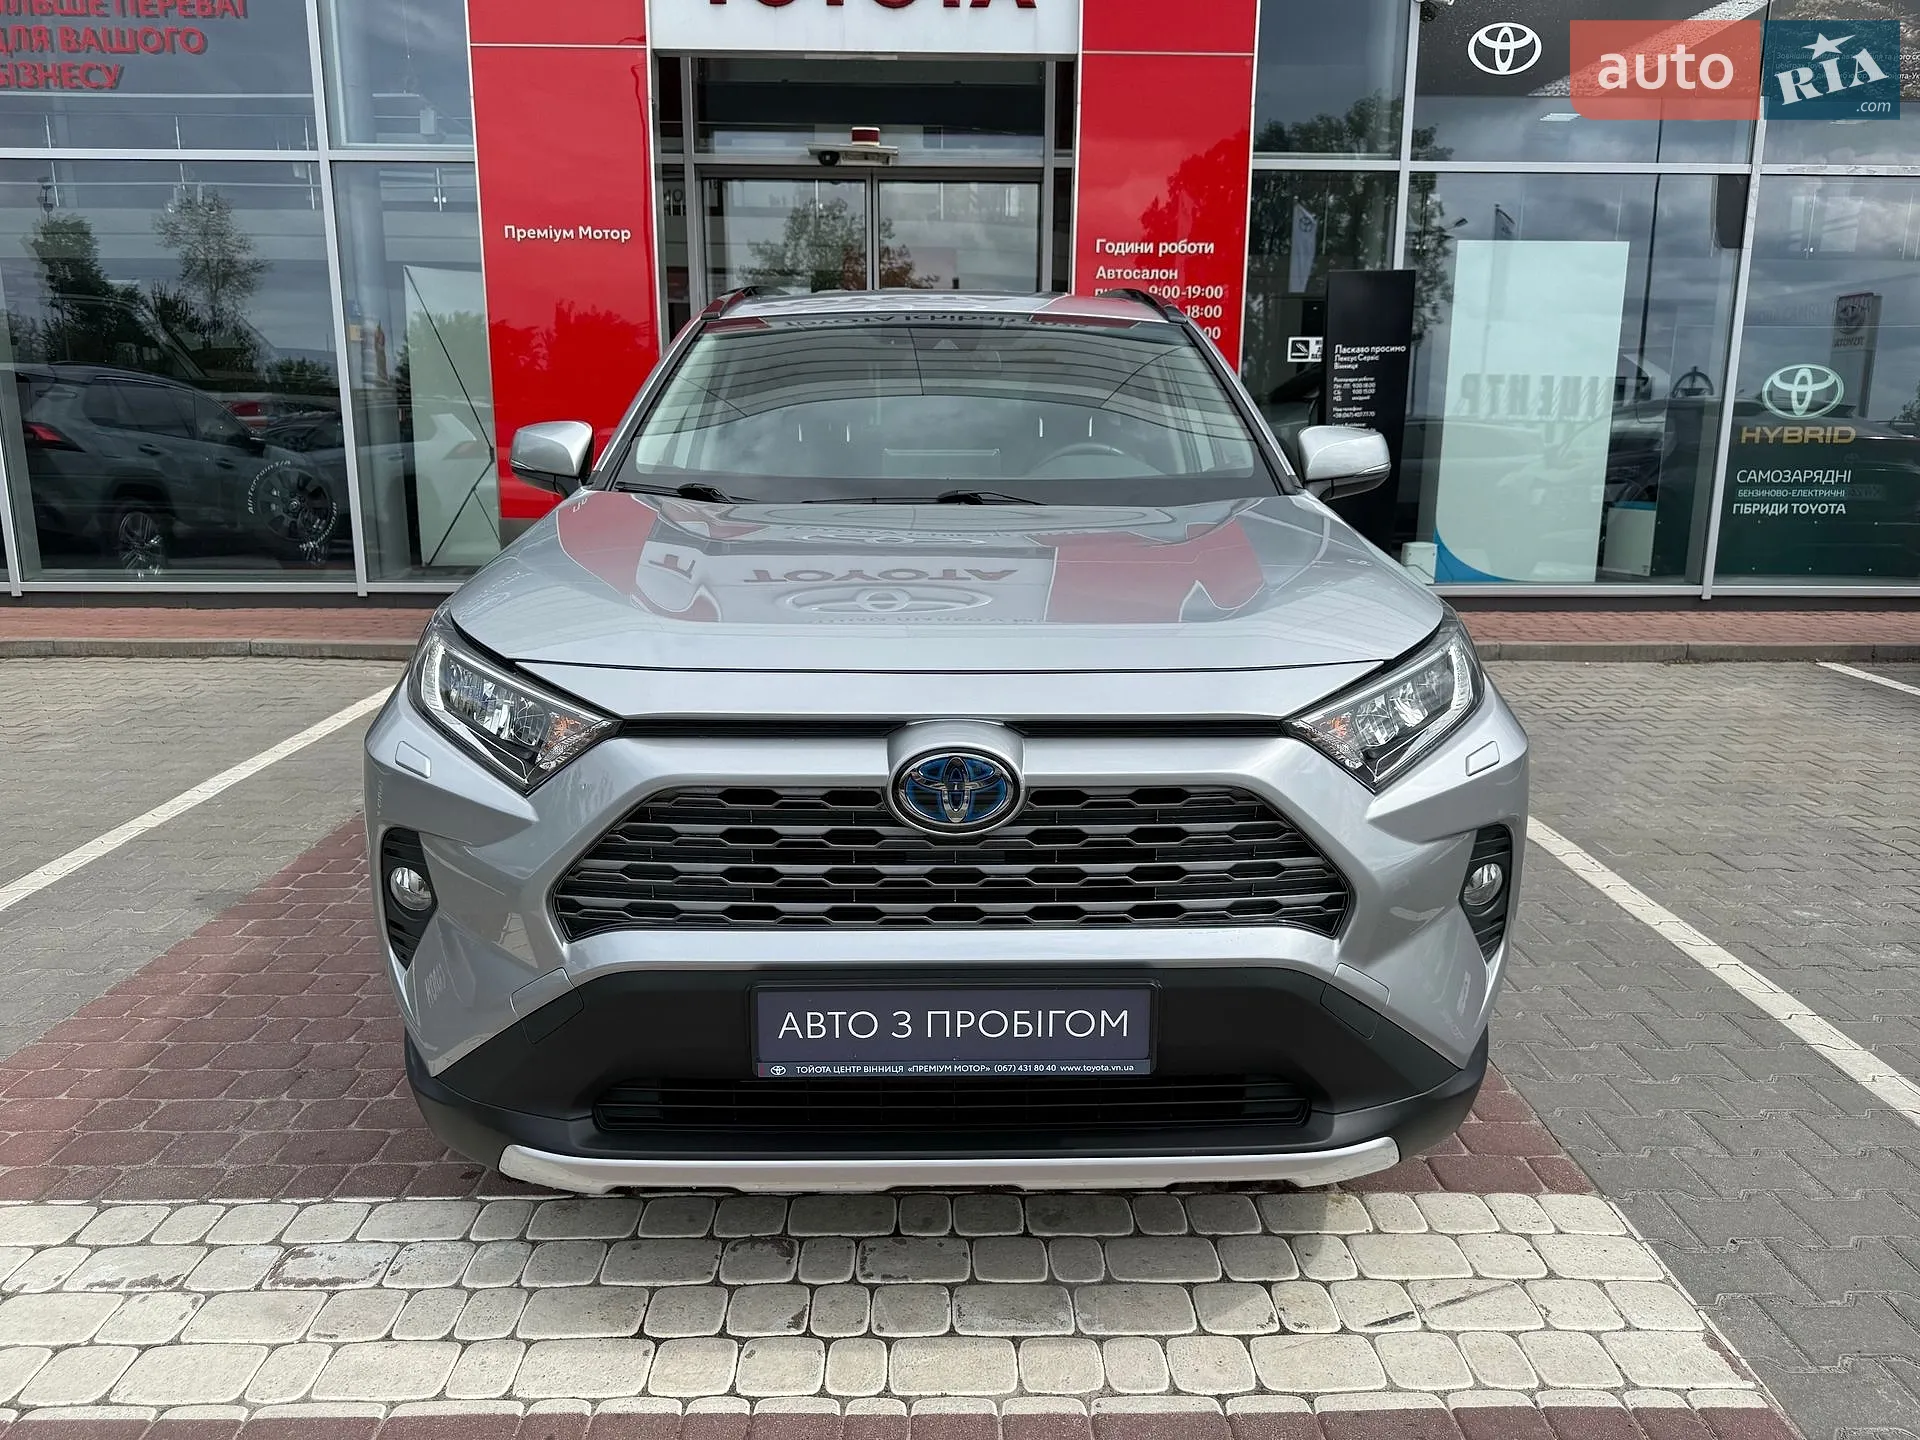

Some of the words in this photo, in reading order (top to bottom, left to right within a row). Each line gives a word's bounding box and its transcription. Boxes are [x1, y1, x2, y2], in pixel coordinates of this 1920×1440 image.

[0, 25, 51, 56] ЛЯ
[58, 26, 206, 54] ВАШОГО
[503, 225, 575, 242] Преміум
[578, 226, 632, 242] Мотор
[1095, 239, 1154, 256] Години
[1158, 239, 1215, 257] роботи
[1095, 265, 1179, 280] Автосалон
[1741, 426, 1857, 444] HYBRID
[1736, 469, 1852, 484] САМОЗАРЯДНІ
[1737, 489, 1846, 498] БЕНЗИНОВО-ЕЛЕКТРИЧНІ
[1732, 503, 1789, 516] ГІБРИДИ
[1791, 503, 1847, 514] TOYOTA
[778, 1010, 879, 1039] АВТО
[926, 1009, 1130, 1039] ПРОБІГОМ
[796, 1065, 832, 1074] ТОЙОТА
[833, 1065, 862, 1075] ЦЕНТР
[864, 1065, 904, 1075] ВІННИЦЯ
[908, 1064, 952, 1073] «ПРЕМІУМ
[954, 1064, 991, 1073] МОТОР»
[994, 1064, 1016, 1073] (067)
[1060, 1065, 1134, 1074] www.toyota.vn.ua
